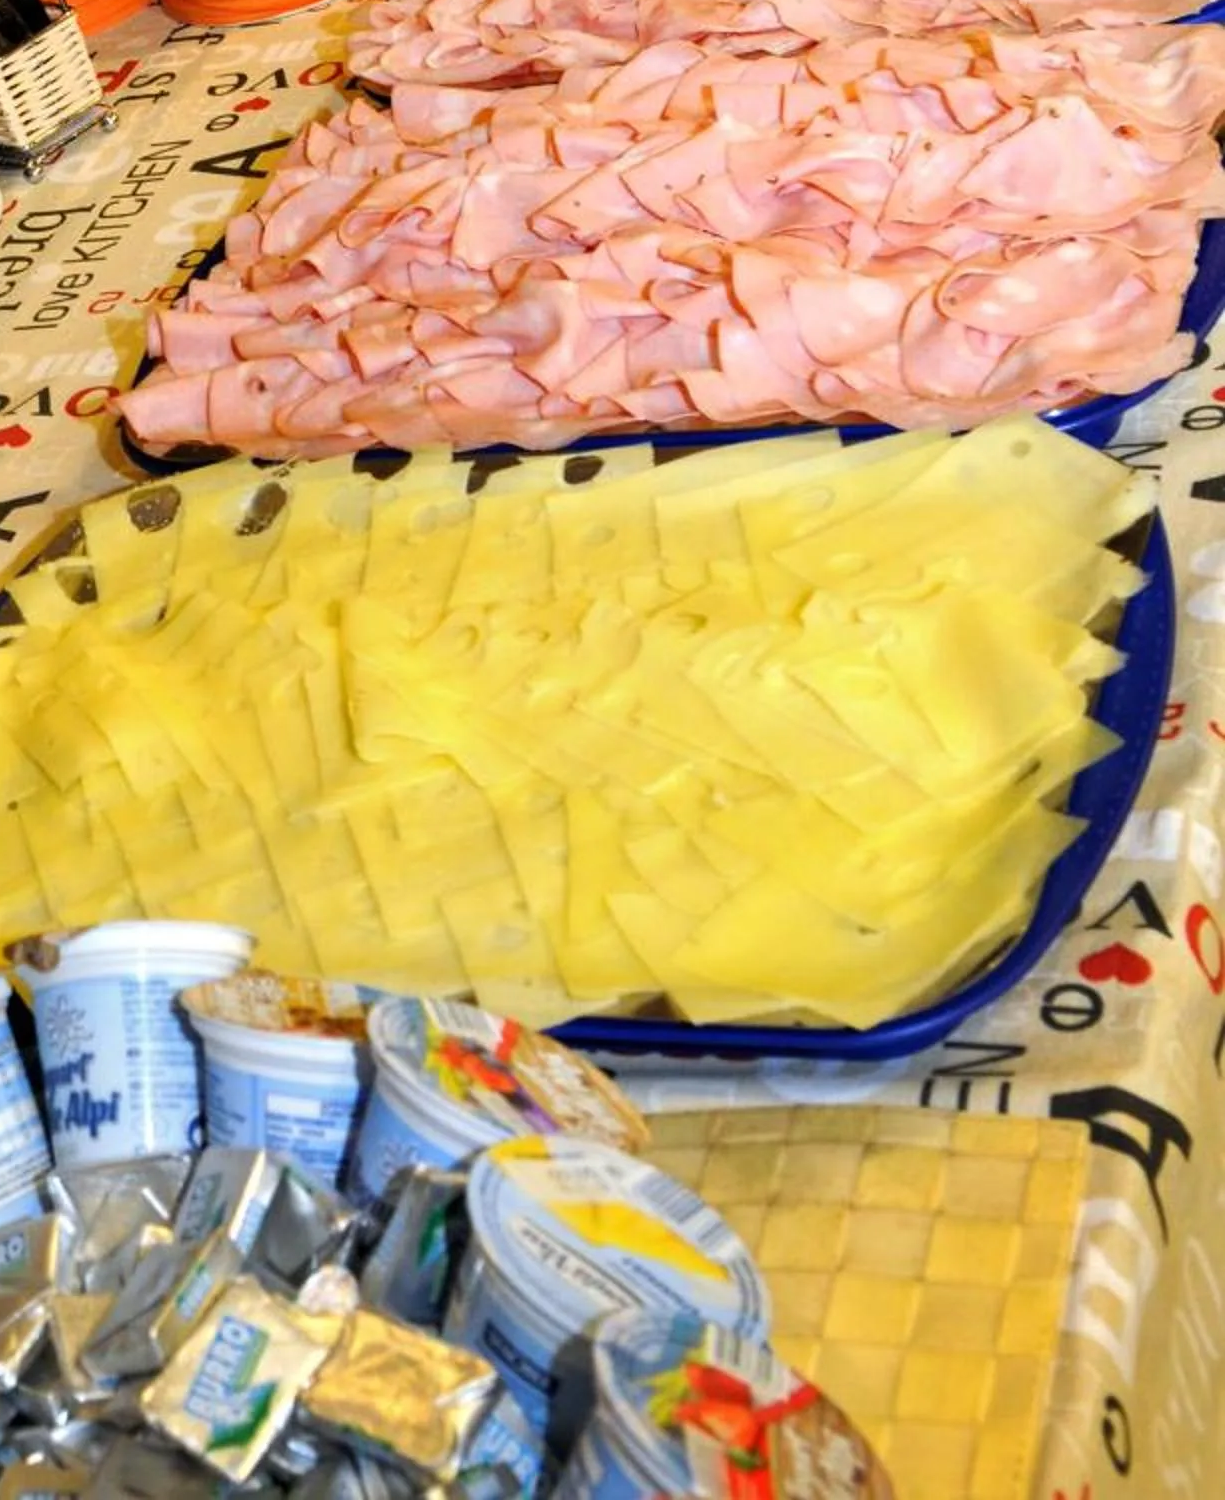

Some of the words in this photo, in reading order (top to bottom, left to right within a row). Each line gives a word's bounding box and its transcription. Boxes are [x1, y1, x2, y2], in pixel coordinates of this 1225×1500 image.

[205, 61, 345, 99] ove
[191, 137, 293, 179] A
[13, 270, 94, 332] love
[77, 137, 193, 264] KITCHEN
[64, 1088, 121, 1139] Alpi
[185, 1322, 252, 1426] BURRO
